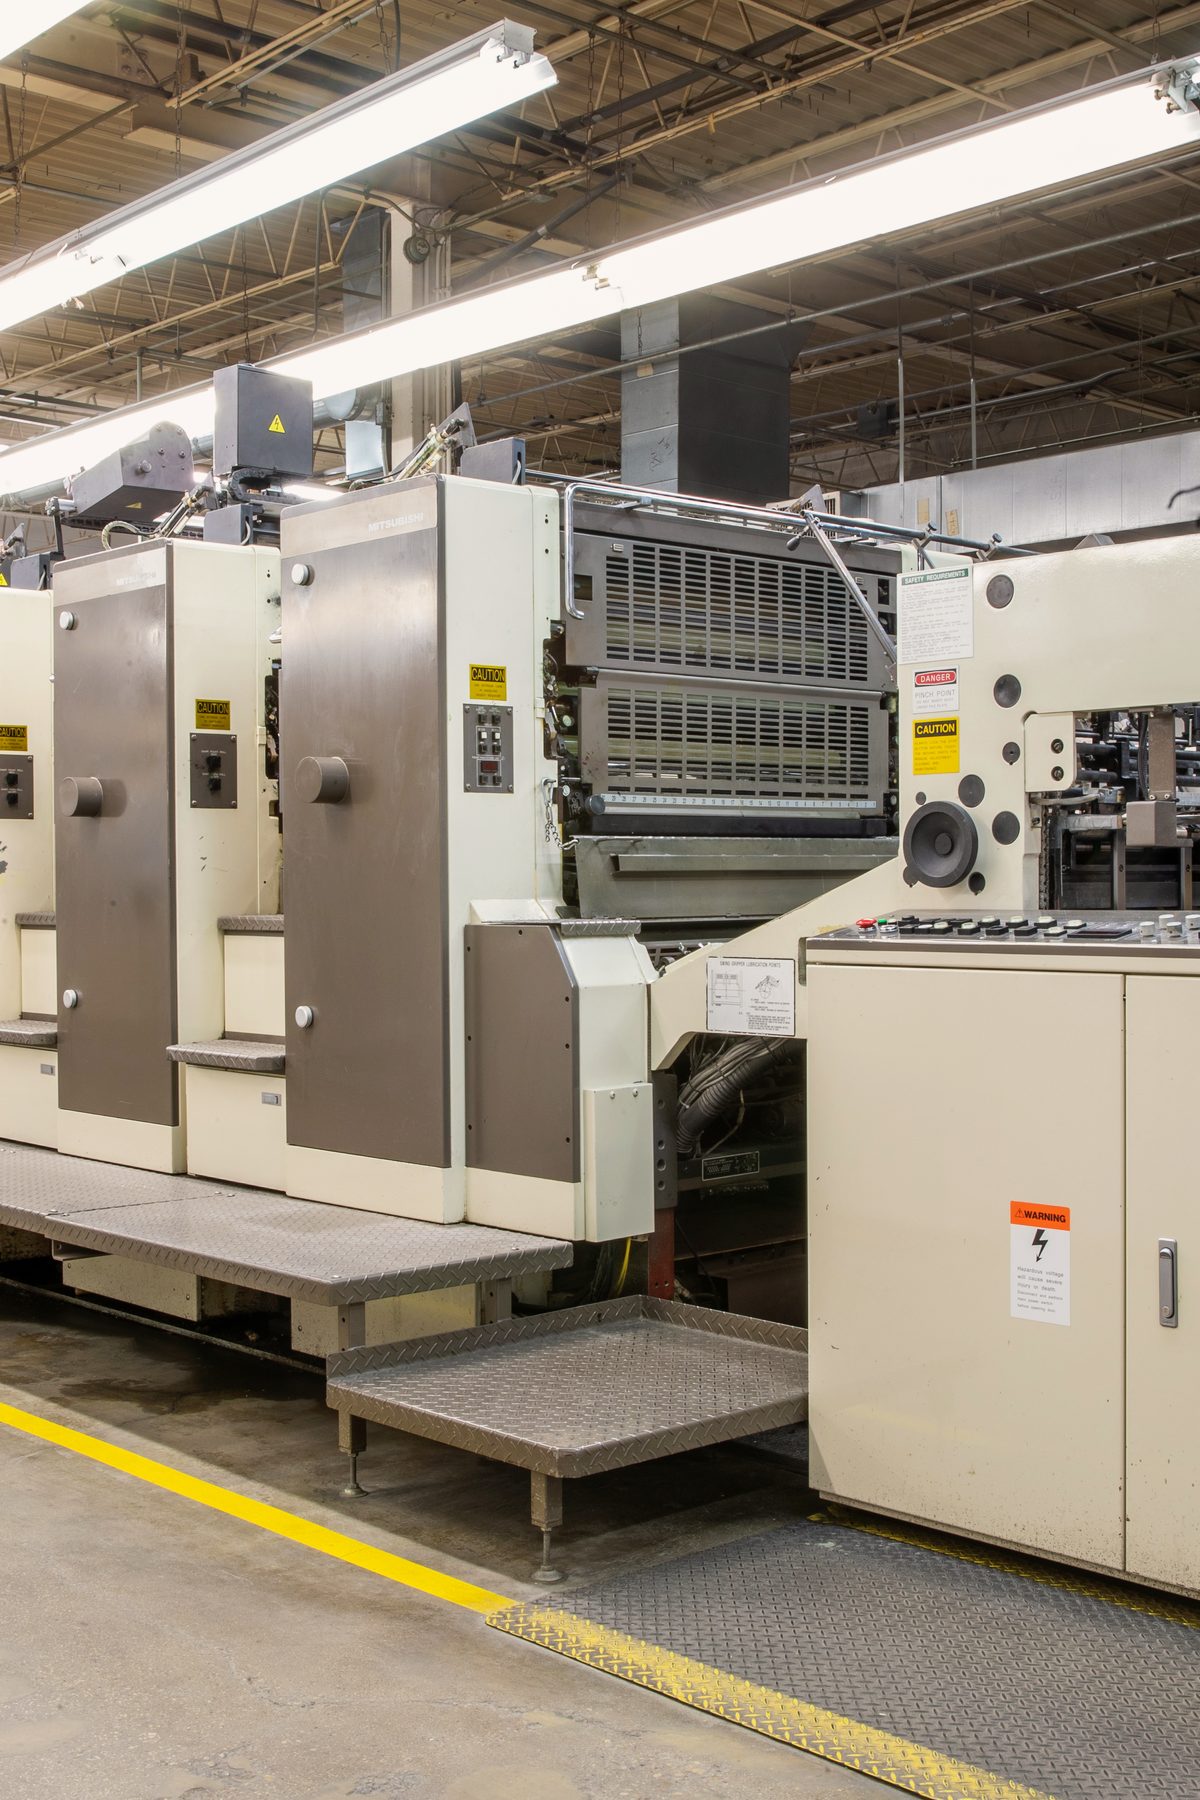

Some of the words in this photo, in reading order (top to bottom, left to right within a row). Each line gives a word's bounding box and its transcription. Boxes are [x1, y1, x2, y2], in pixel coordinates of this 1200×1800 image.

[368, 512, 423, 532] MITSUBISHI
[904, 576, 924, 585] SAFETY
[926, 570, 965, 581] REQUIREMENTS
[471, 668, 505, 681] CAUTION
[920, 673, 951, 683] DANGER
[936, 689, 955, 697] POINT
[197, 702, 229, 714] CAUTION
[916, 723, 955, 735] CAUTION
[1023, 1210, 1066, 1223] WARNING
